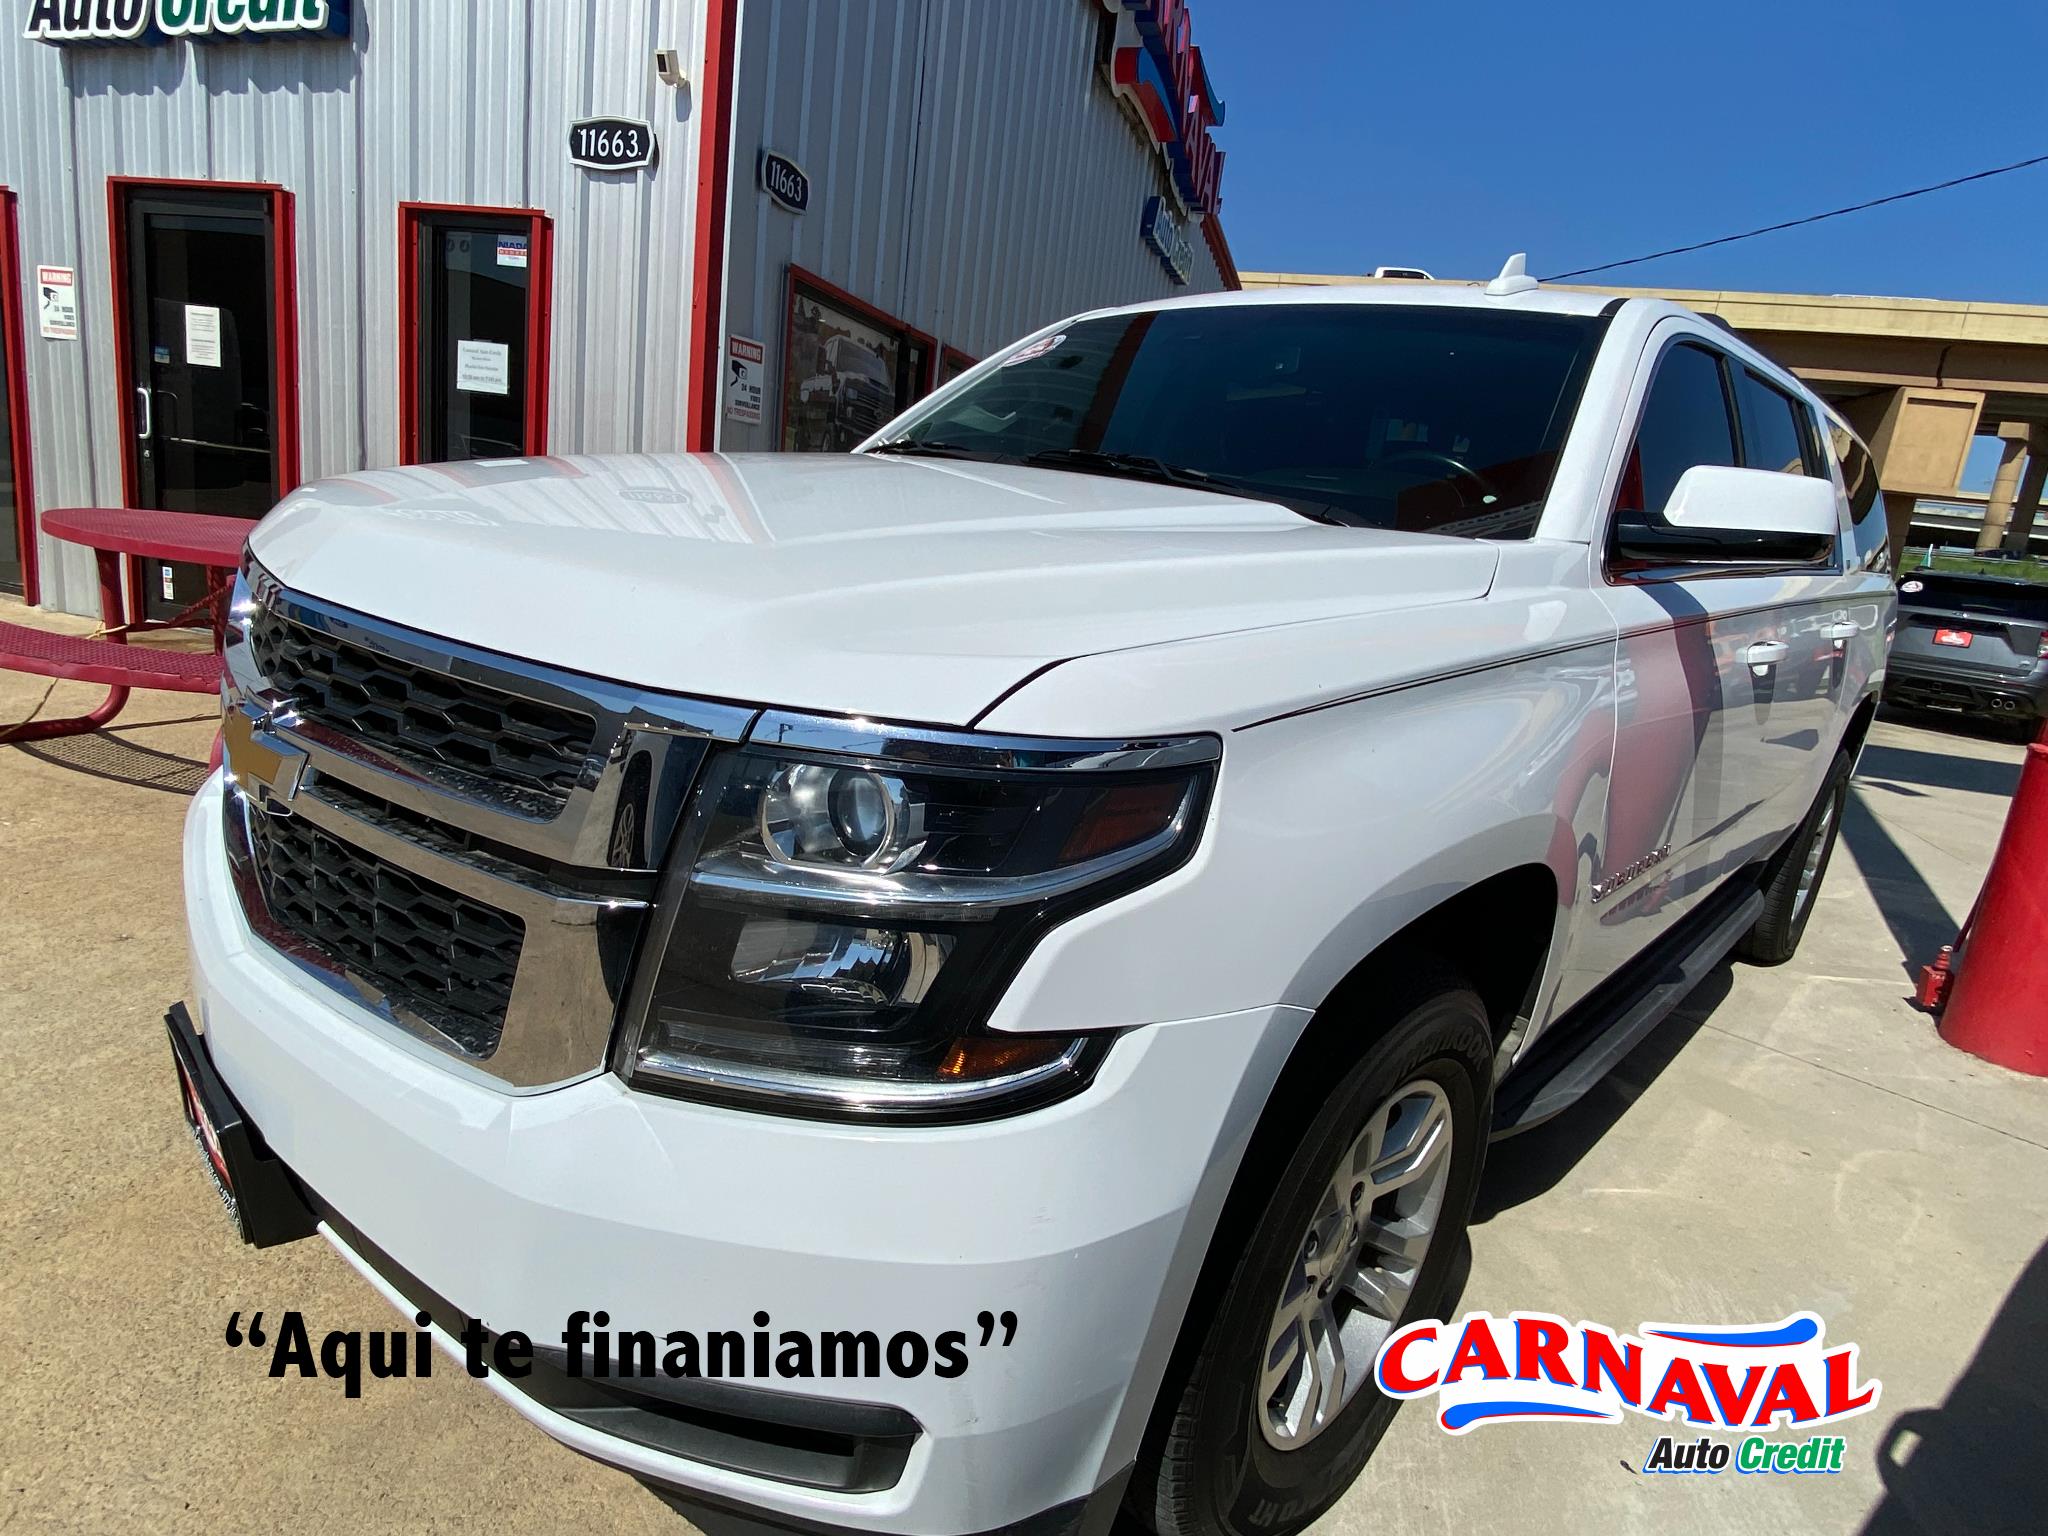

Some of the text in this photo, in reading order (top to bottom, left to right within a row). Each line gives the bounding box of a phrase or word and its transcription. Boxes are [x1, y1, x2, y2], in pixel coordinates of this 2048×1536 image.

[26, 0, 324, 33] Auto Credit
[580, 128, 639, 158] 11663
[771, 160, 803, 202] 11663
[42, 270, 72, 284] WARNING
[731, 340, 762, 362] WARNING
